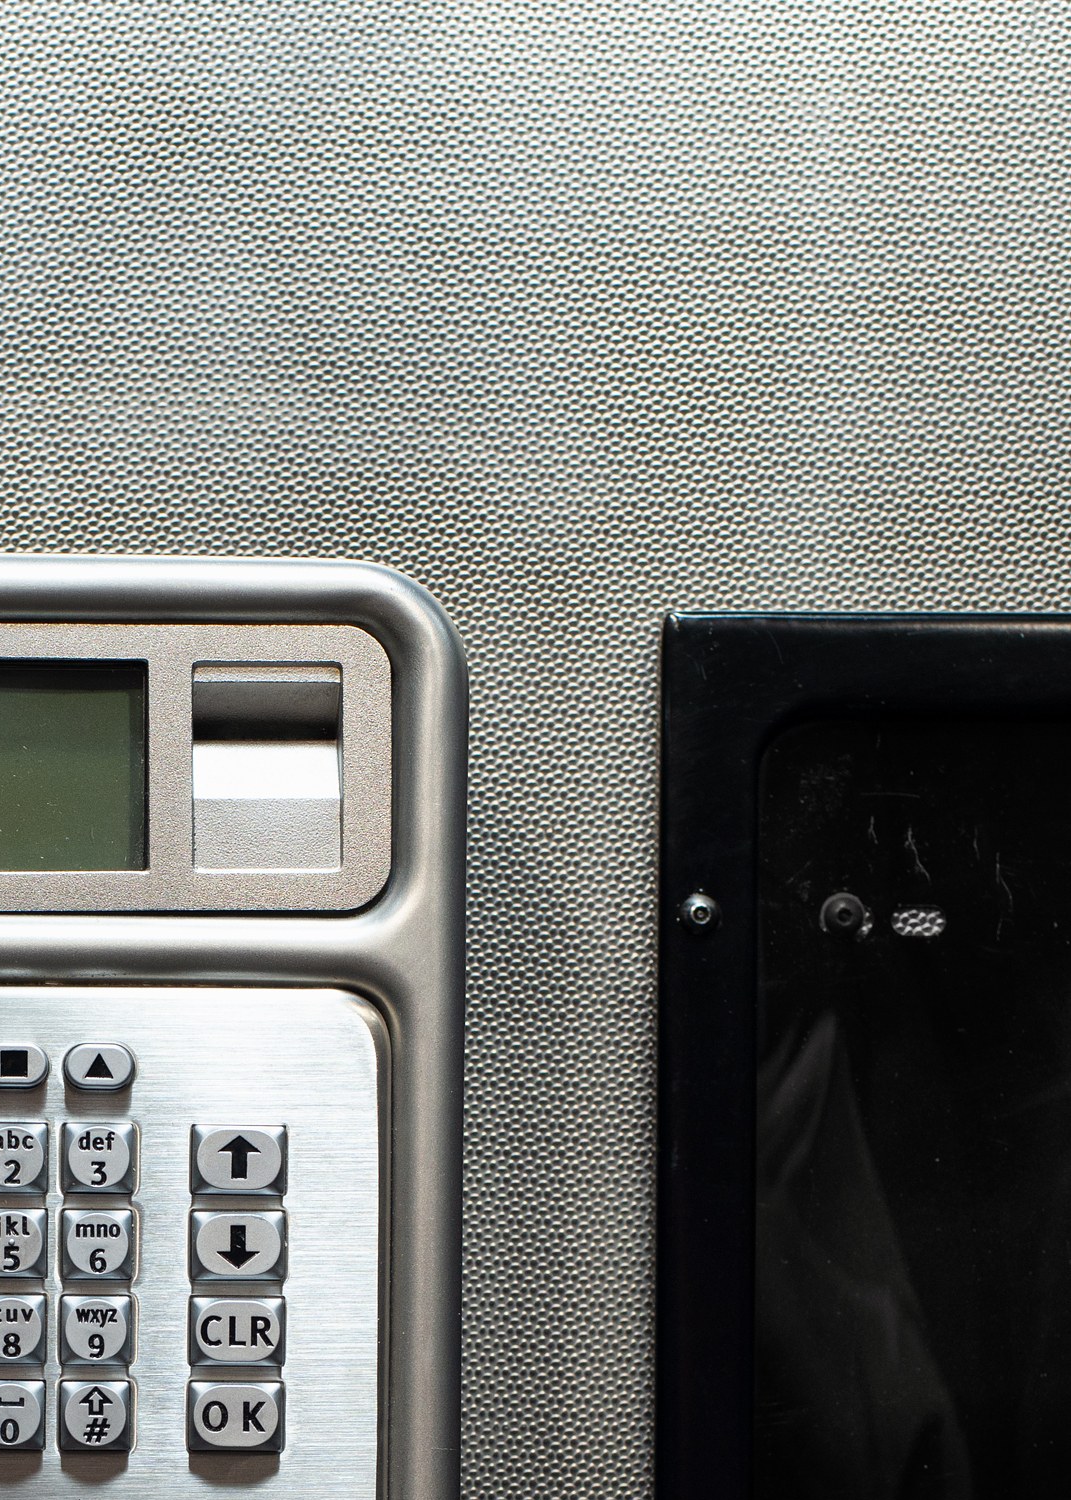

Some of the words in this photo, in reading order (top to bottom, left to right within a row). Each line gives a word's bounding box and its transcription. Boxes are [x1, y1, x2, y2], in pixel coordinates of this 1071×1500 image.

[78, 1131, 115, 1151] def
[4, 1159, 21, 1184] 2
[91, 1161, 107, 1186] 3
[75, 1223, 121, 1238] mno
[3, 1245, 20, 1271] 5
[89, 1248, 107, 1273] 6
[76, 1308, 118, 1328] wxyz
[200, 1315, 274, 1347] CLR
[2, 1333, 21, 1357] 8
[88, 1334, 105, 1358] 9
[0, 1419, 20, 1443] 0
